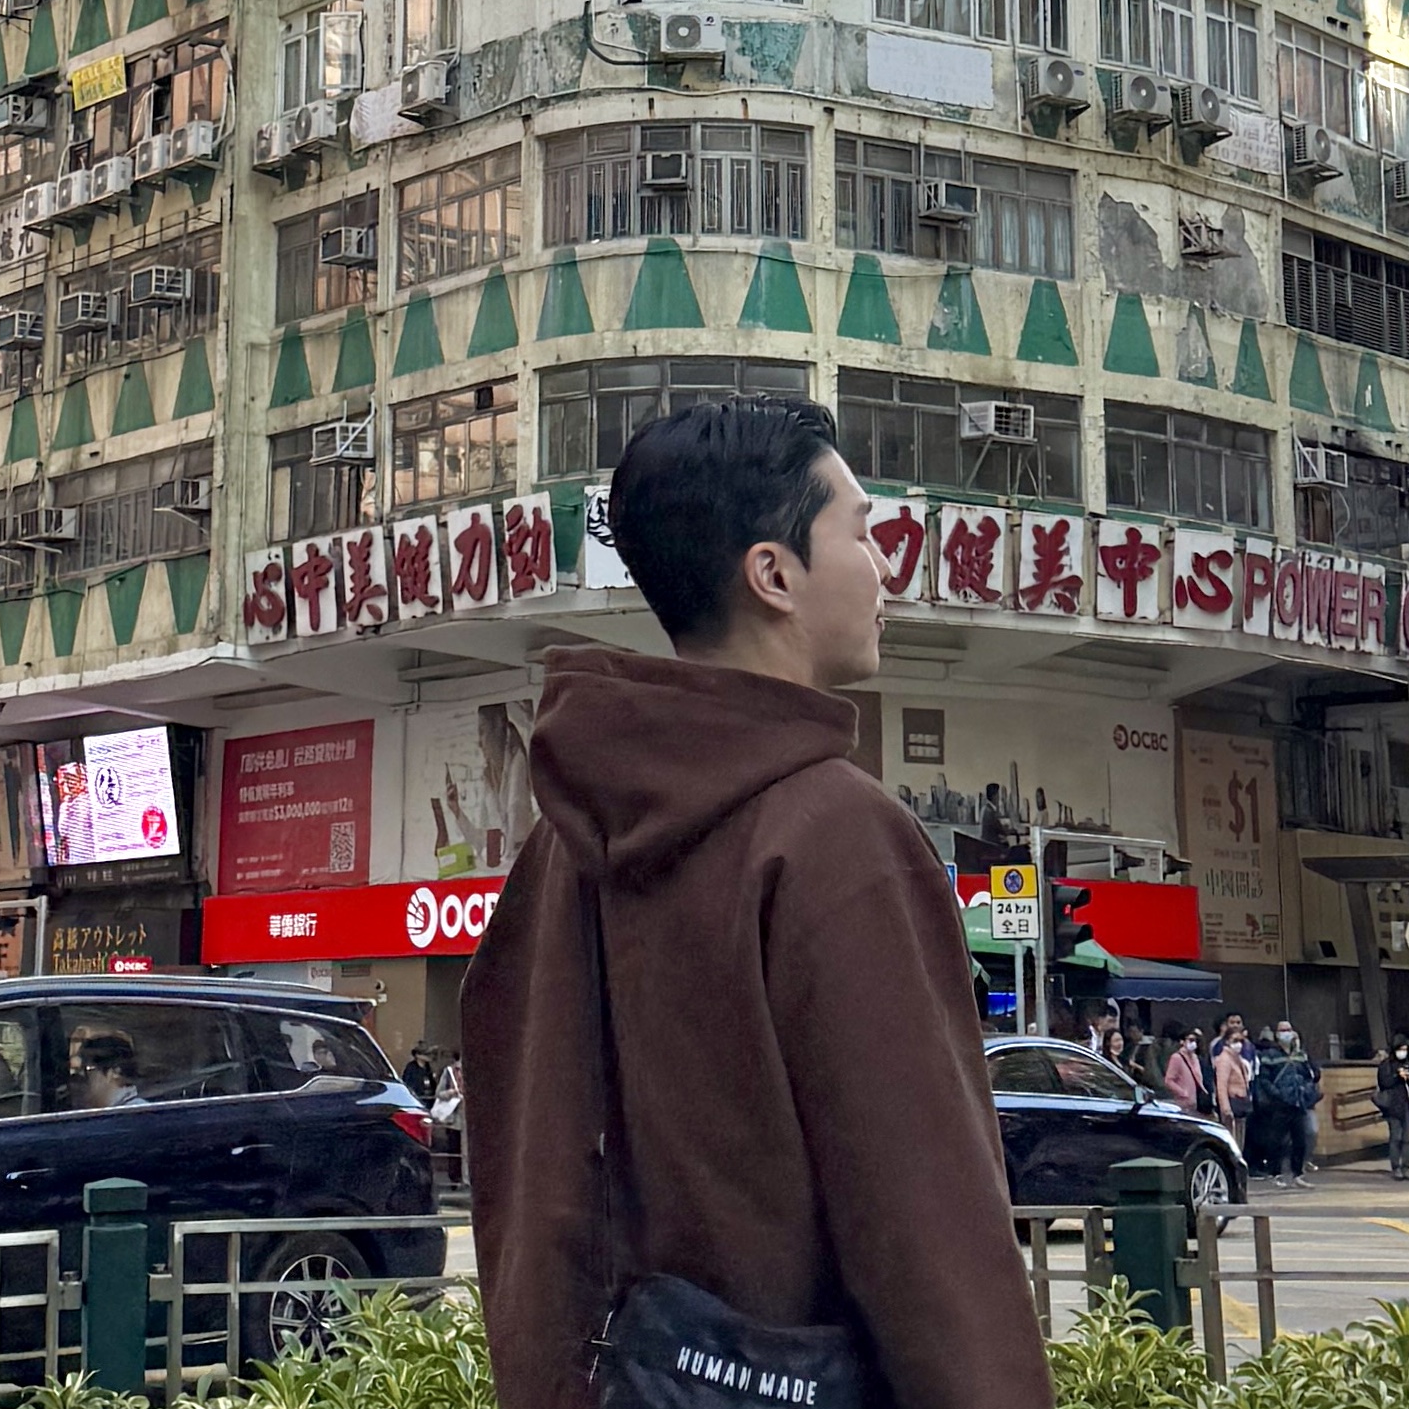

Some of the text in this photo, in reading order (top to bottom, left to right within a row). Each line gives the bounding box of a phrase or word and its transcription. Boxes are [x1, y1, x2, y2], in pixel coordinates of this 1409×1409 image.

[1243, 553, 1387, 644] POWER
[1129, 730, 1169, 752] OCBC
[1228, 769, 1260, 844] $1
[997, 903, 1014, 915] 24
[1000, 918, 1030, 935] 全日
[677, 1346, 818, 1406] HUMAN MADE
